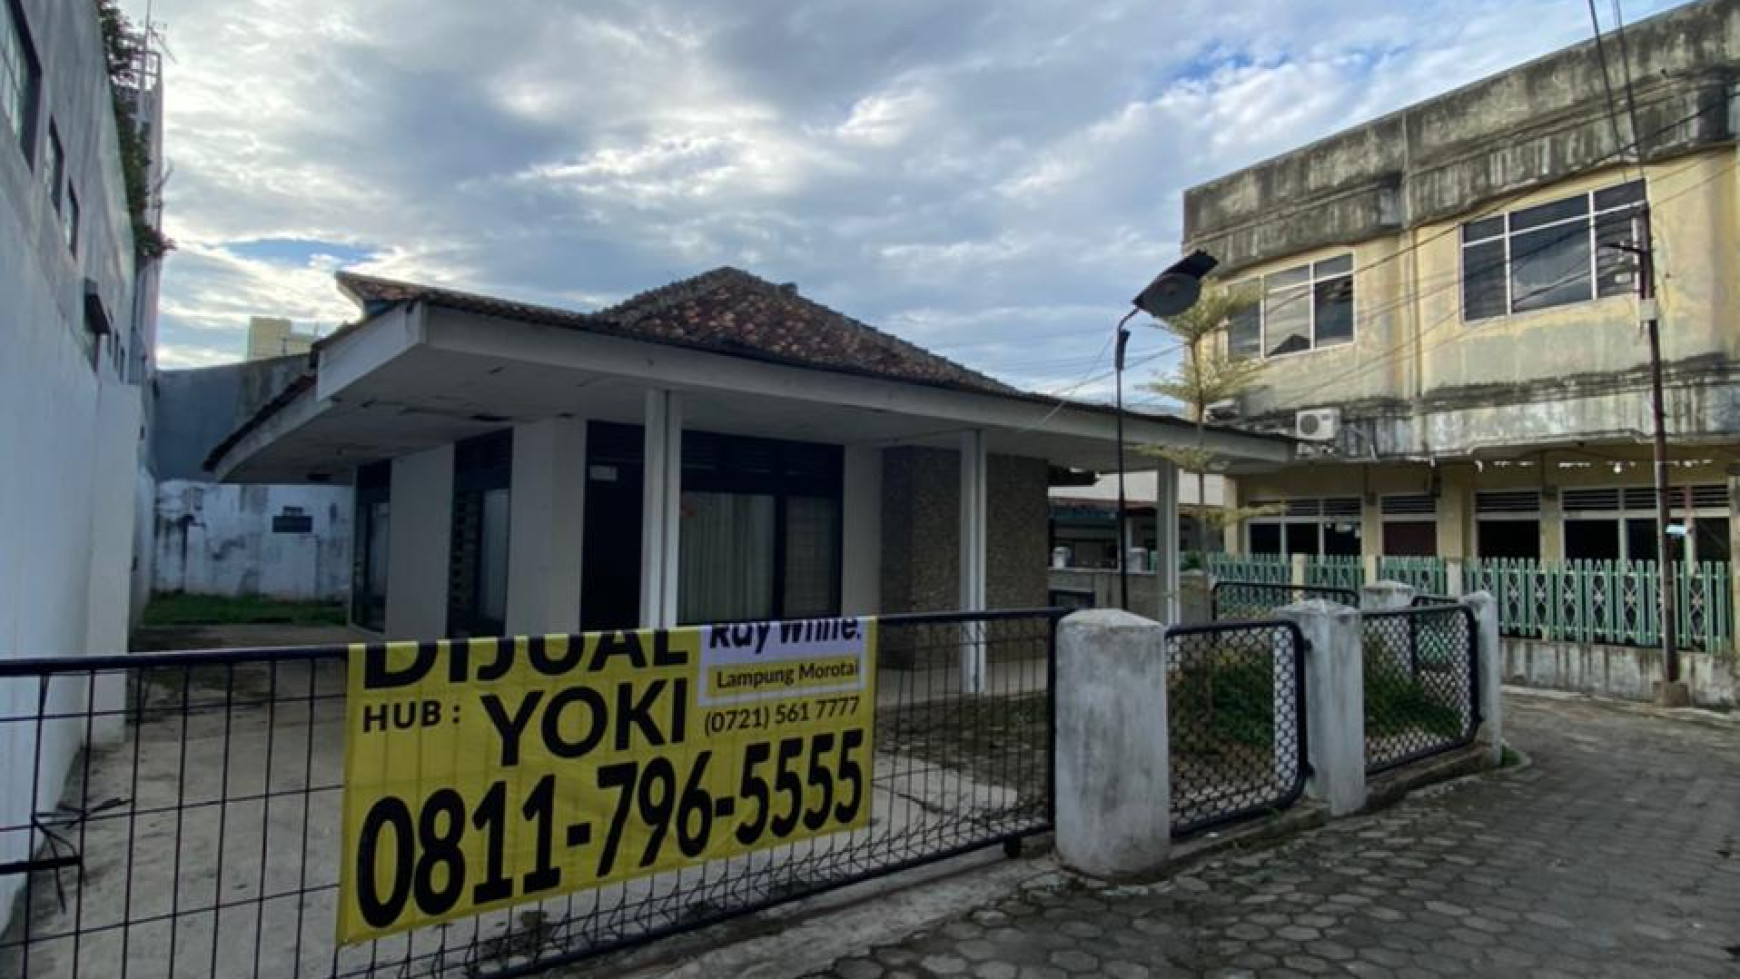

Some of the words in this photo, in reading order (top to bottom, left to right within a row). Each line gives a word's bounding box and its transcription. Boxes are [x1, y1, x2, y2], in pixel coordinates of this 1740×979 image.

[716, 667, 795, 690] Lampung
[798, 660, 860, 681] Morotai
[480, 676, 689, 767] YOKI
[704, 704, 770, 738] (0721)
[774, 701, 810, 726] 561
[814, 695, 860, 721] 7777
[357, 728, 864, 929] 0811-796-5555
